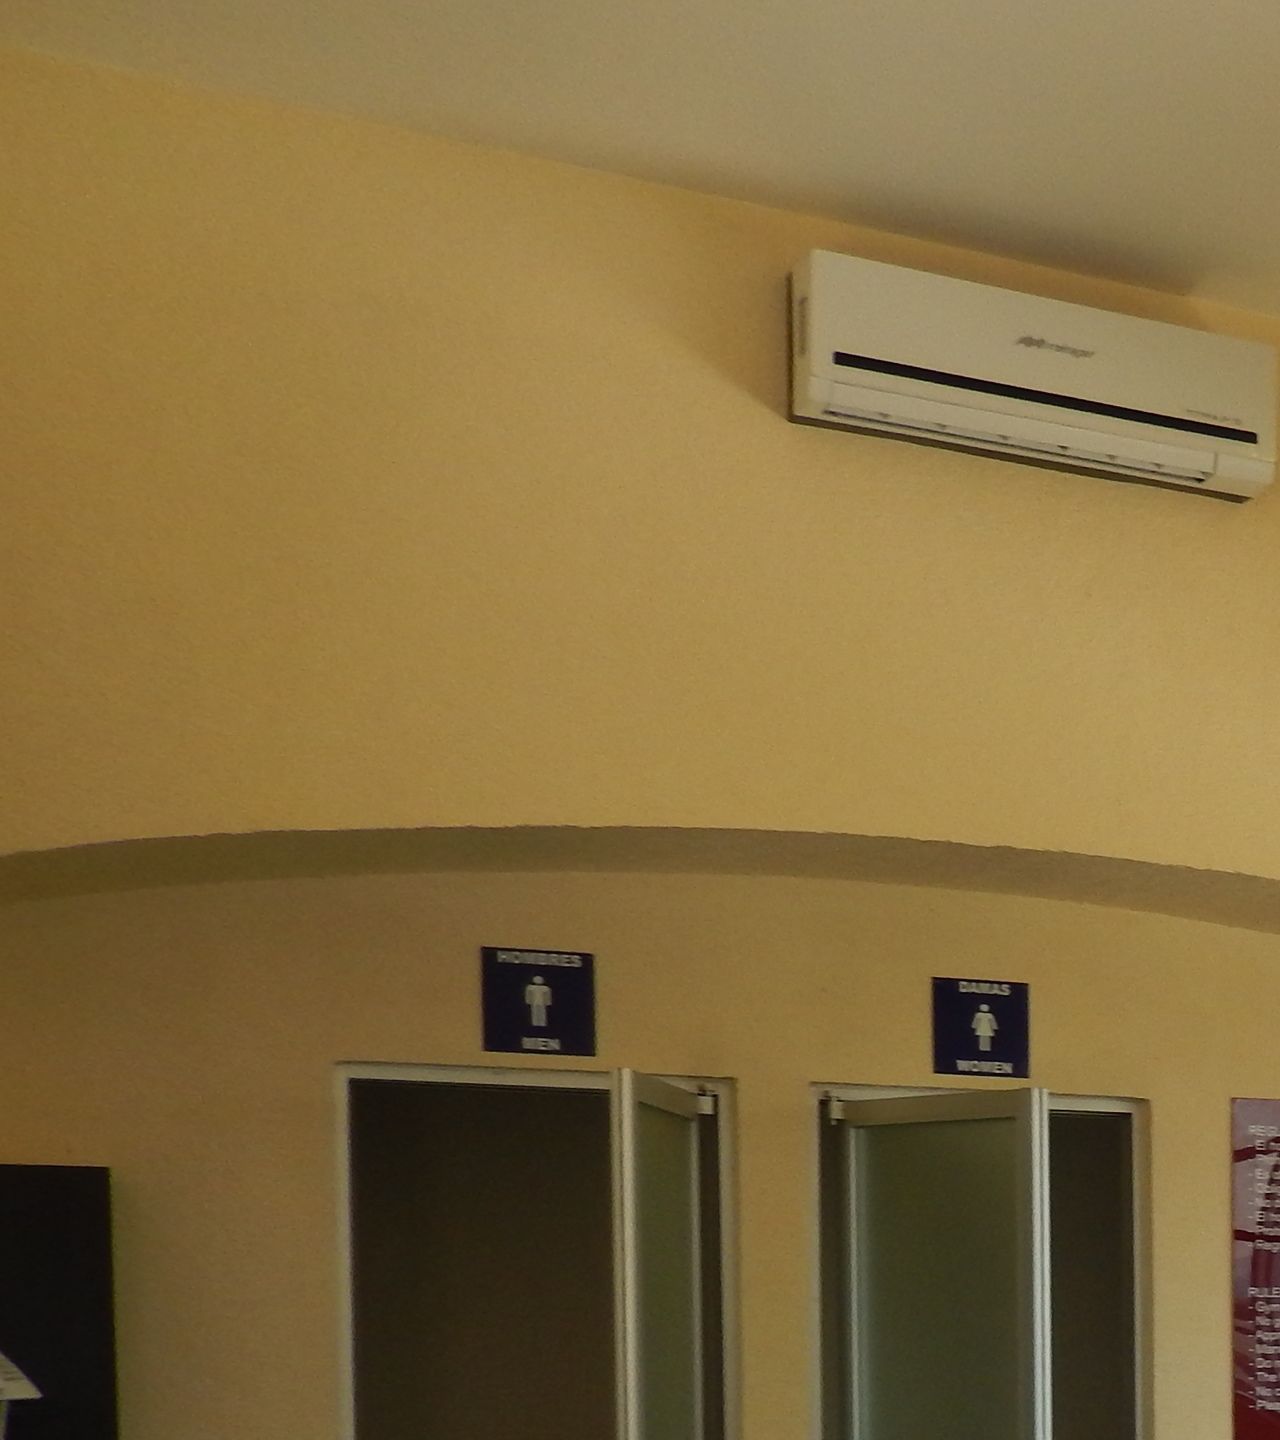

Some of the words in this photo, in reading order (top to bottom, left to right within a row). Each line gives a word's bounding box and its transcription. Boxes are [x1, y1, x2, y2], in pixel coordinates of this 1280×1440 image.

[497, 950, 583, 968] HOMBRES
[958, 980, 1012, 996] DAMAS
[521, 1036, 562, 1051] MEN
[955, 1059, 1014, 1074] WOMEN
[1255, 1301, 1280, 1314] Gym
[1255, 1357, 1272, 1368] Do
[1255, 1371, 1278, 1381] The
